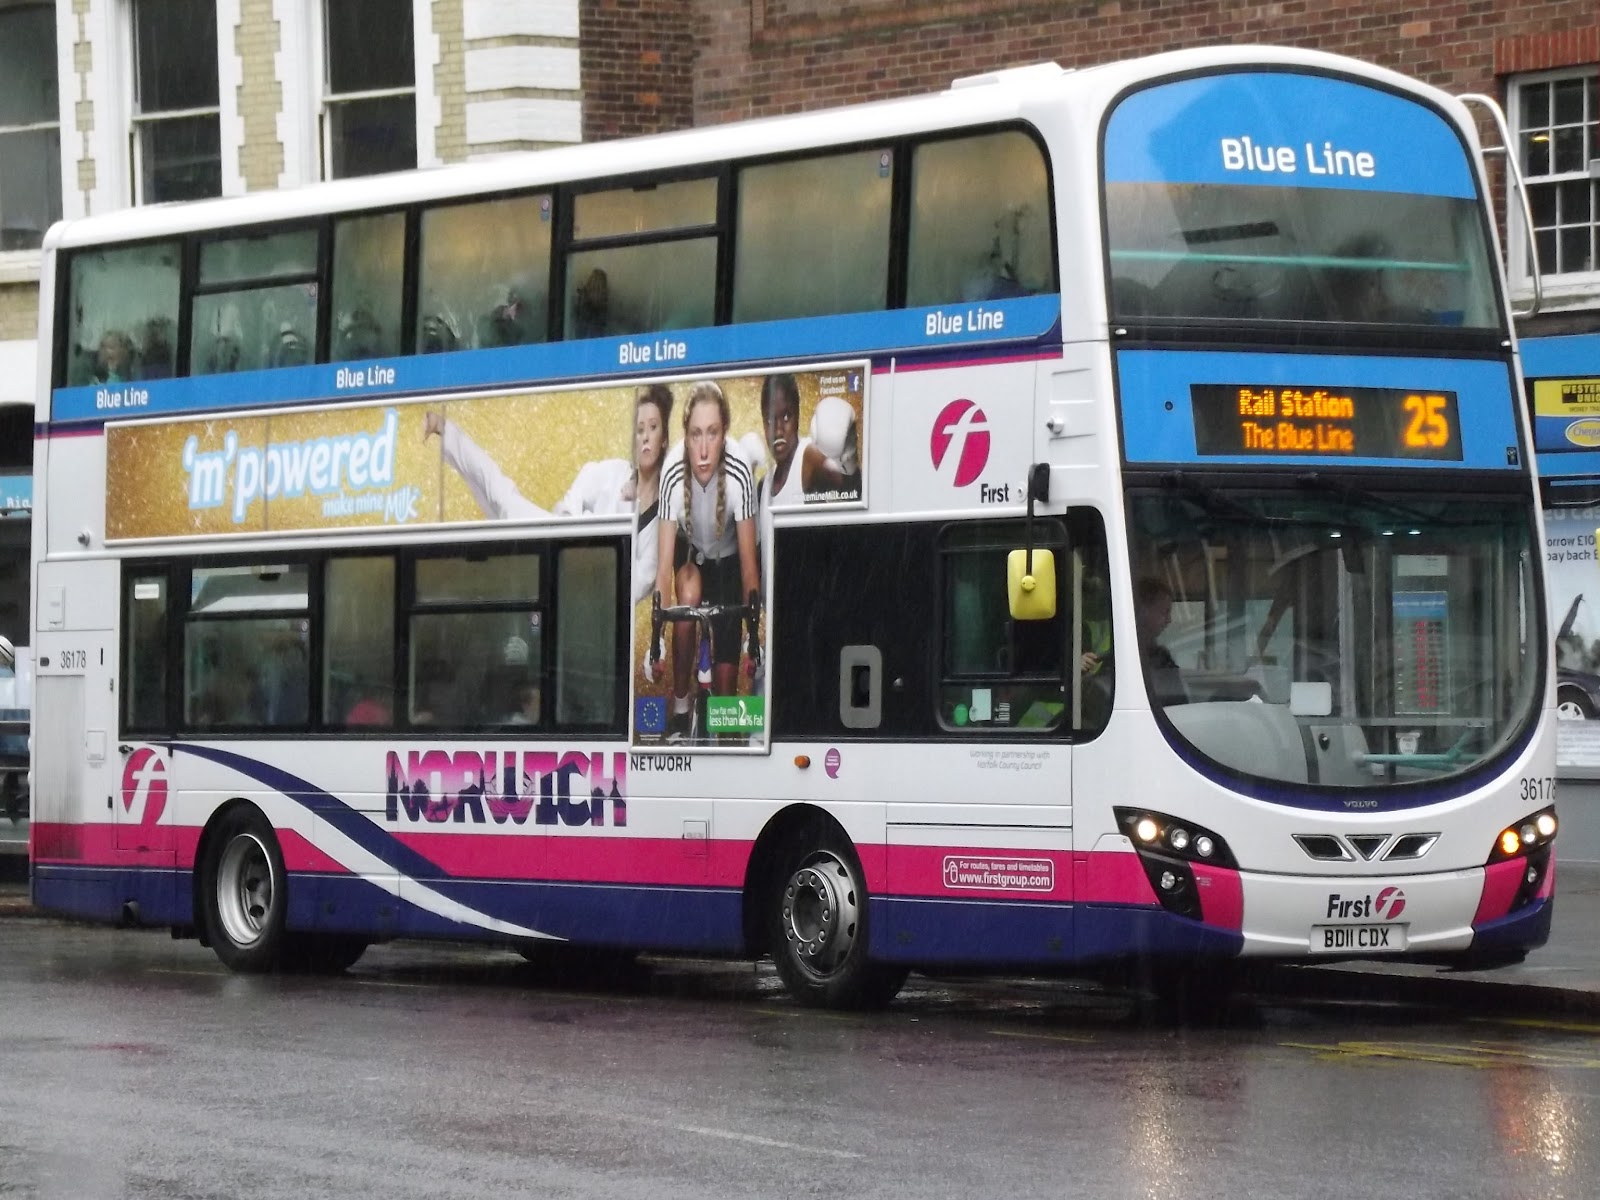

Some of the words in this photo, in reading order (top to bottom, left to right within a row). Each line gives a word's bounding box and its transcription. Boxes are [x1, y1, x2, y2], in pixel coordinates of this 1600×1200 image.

[1221, 136, 1296, 173] Blue
[1305, 142, 1375, 178] Line
[926, 310, 963, 335] Blue
[967, 307, 1004, 332] Line
[619, 341, 651, 364] Blue
[655, 338, 687, 361] Line
[336, 367, 364, 389] Blue
[367, 364, 395, 386] Line
[96, 388, 121, 409] Blue
[124, 387, 148, 407] Line
[1562, 385, 1600, 394] WESTER
[1239, 388, 1276, 416] Rail
[1280, 390, 1355, 418] Station
[1402, 393, 1450, 448] 25
[1241, 421, 1275, 449] The
[1276, 421, 1314, 451] Blue
[1315, 423, 1355, 451] Line
[980, 483, 1010, 504] First
[1547, 537, 1575, 547] orrow
[1577, 535, 1597, 546] £10
[1567, 550, 1591, 561] back
[60, 650, 87, 669] 36178
[709, 715, 722, 726] less
[722, 715, 738, 726] than
[753, 714, 764, 726] fat
[630, 755, 692, 772] NETWORK
[386, 750, 627, 827] NORWICH
[1343, 800, 1378, 808] VOLVO
[959, 861, 970, 869] For
[991, 862, 1006, 871] fares
[1007, 862, 1018, 871] and
[1019, 862, 1050, 873] timetables
[959, 872, 1050, 888] www.firstgroup.com
[1327, 893, 1372, 919] First
[1324, 929, 1354, 948] BD11
[1358, 927, 1390, 947] CDX
